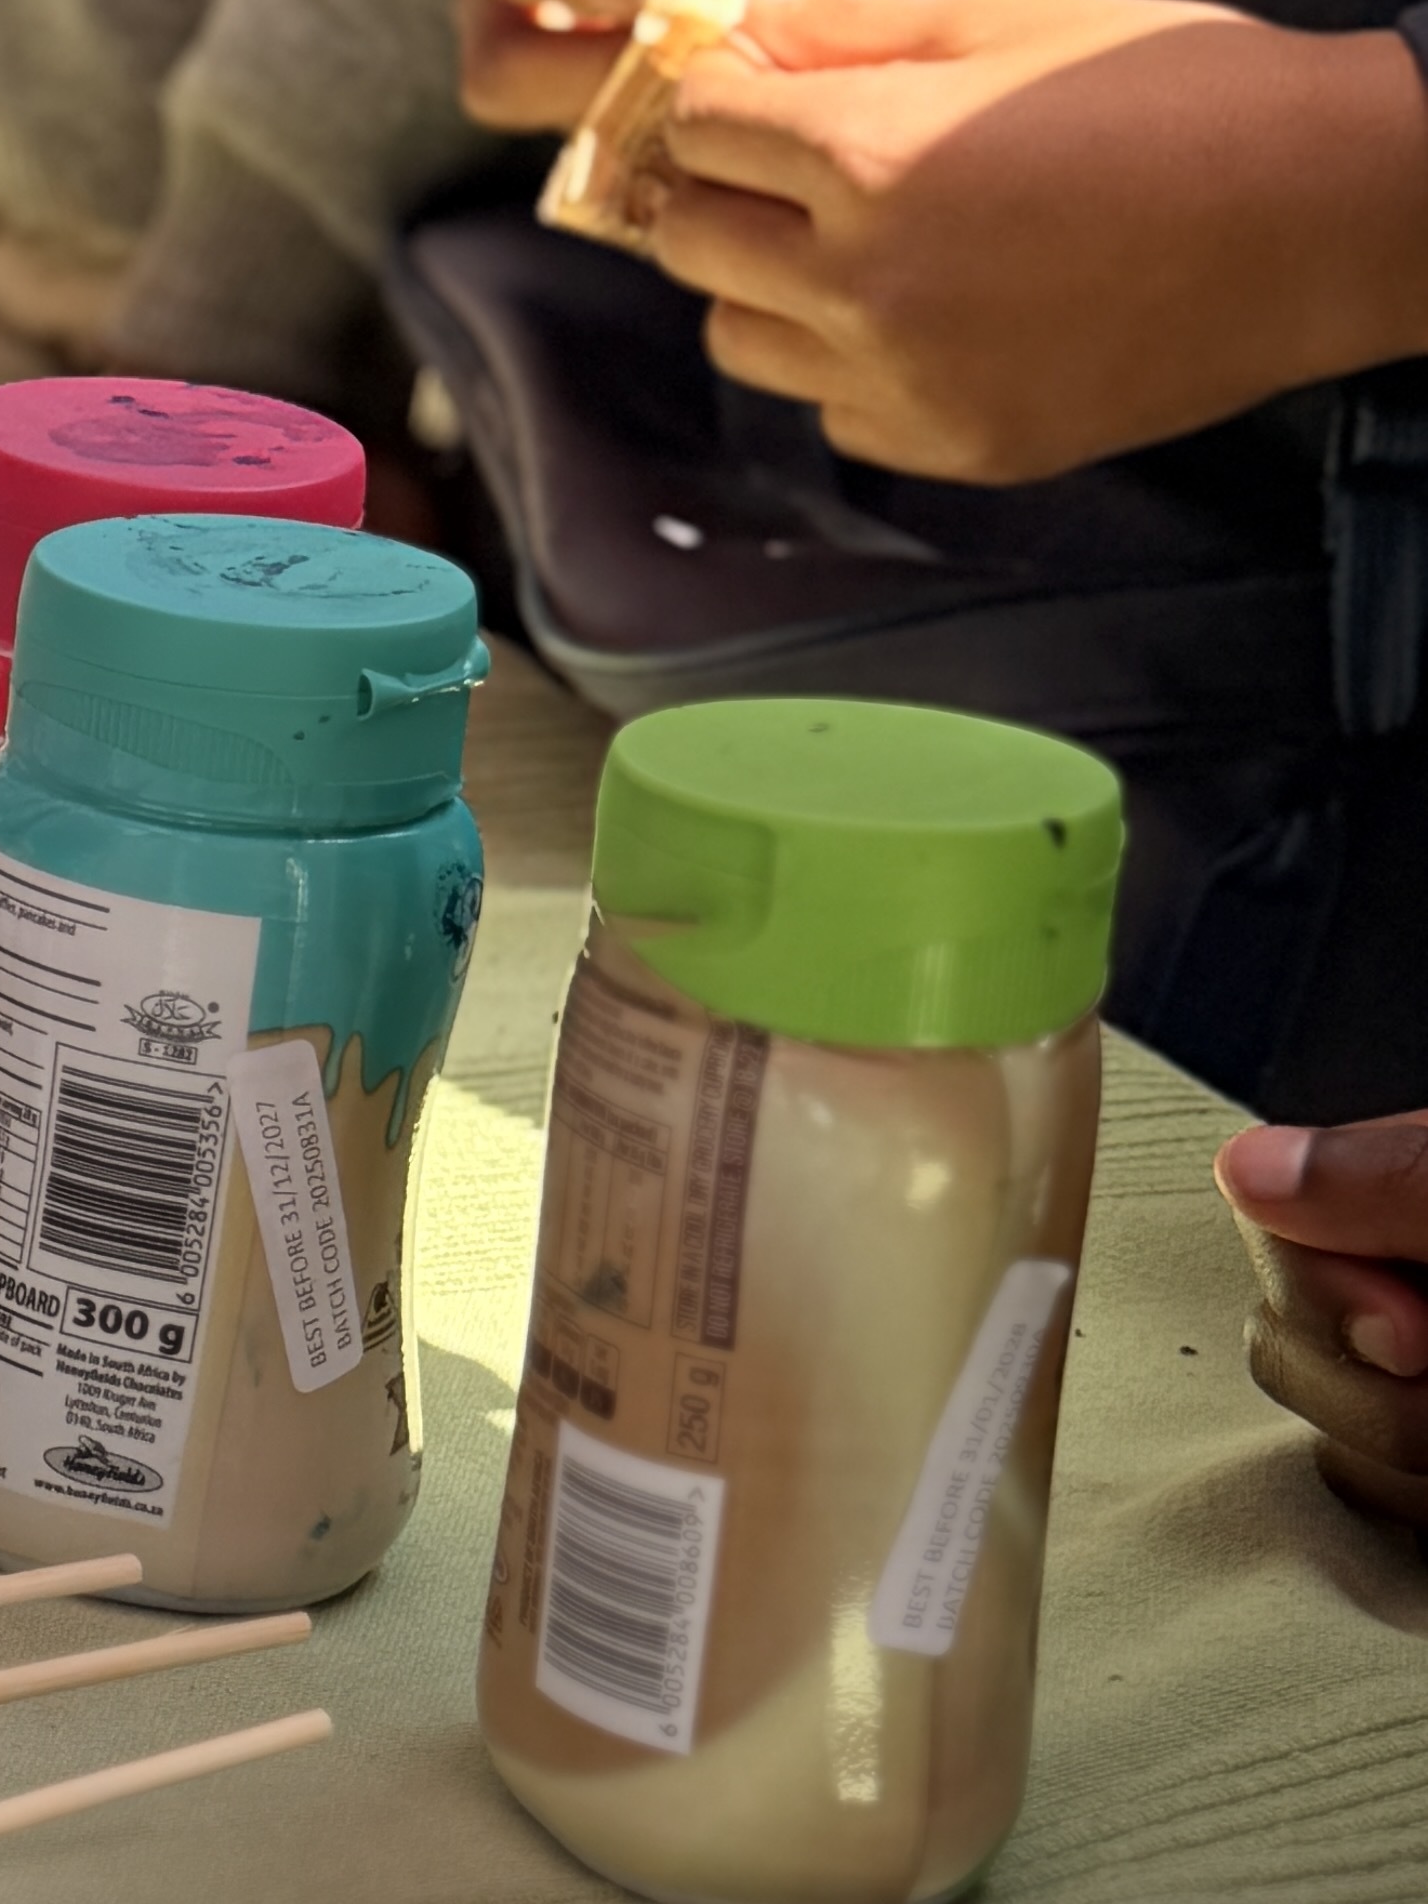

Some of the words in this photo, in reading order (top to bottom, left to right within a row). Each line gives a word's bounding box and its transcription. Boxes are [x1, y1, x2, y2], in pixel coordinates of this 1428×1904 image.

[195, 1105, 222, 1188] 005356
[256, 1101, 300, 1227] 31/12/2027
[292, 1091, 330, 1213] 20250831A
[723, 1111, 748, 1165] STORE
[180, 1197, 210, 1278] 005284
[315, 1216, 340, 1274] CODE
[176, 1291, 195, 1304] 6
[285, 1230, 317, 1312] BEFORE
[709, 1280, 733, 1312] NOT
[72, 1297, 150, 1341] 300
[158, 1323, 186, 1356] g
[303, 1317, 327, 1368] BEST
[327, 1278, 352, 1350] BATCH
[706, 1312, 729, 1339] DO
[56, 1343, 87, 1363] Made
[88, 1352, 100, 1366] in
[102, 1356, 135, 1374] South
[137, 1363, 170, 1383] Africa
[171, 1370, 186, 1386] by
[688, 1364, 720, 1388] g
[677, 1393, 710, 1454] 250
[903, 1569, 935, 1629] BEST
[923, 1470, 969, 1563] BEFORE
[958, 1322, 1027, 1463] 31/01/2028
[676, 1512, 704, 1607] 008609
[661, 1617, 690, 1710] 005284
[658, 1721, 679, 1738] 6
